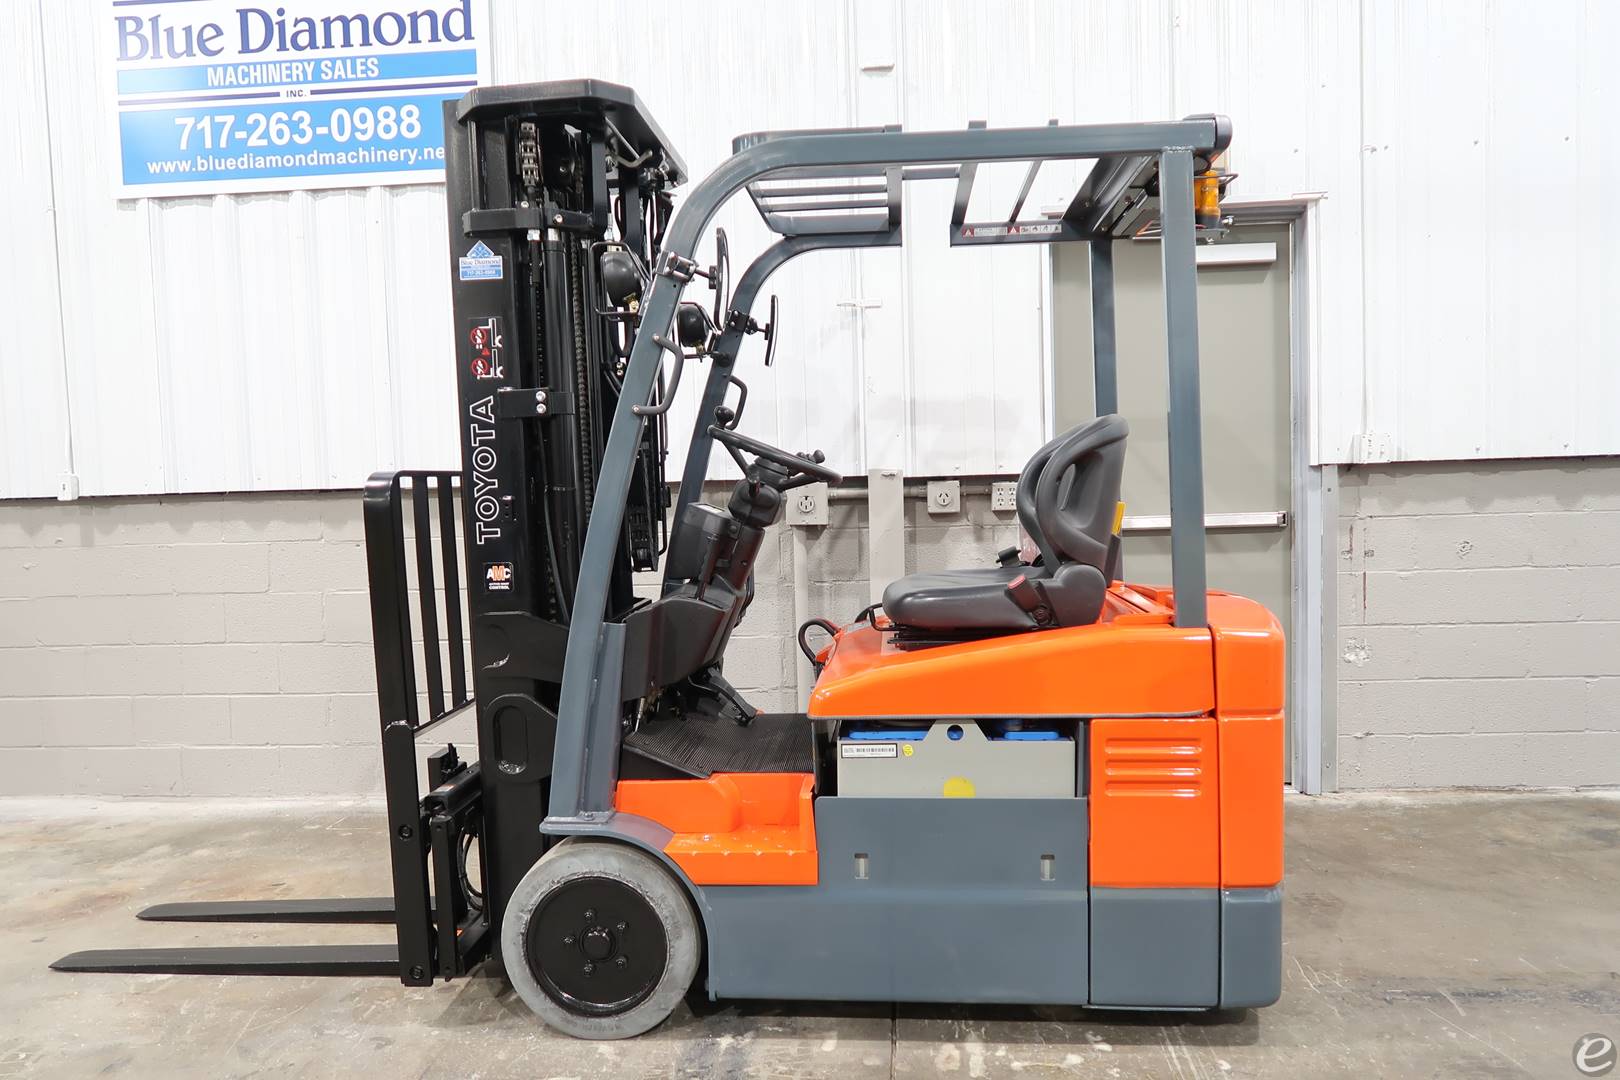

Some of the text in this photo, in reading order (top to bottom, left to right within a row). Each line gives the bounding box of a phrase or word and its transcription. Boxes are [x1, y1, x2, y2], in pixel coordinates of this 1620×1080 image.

[114, 0, 475, 62] Blue Diamond
[207, 57, 379, 87] MACHINERY SALES
[286, 88, 307, 98] INC.
[174, 104, 422, 151] 717-263-0988
[146, 147, 446, 175] www.bluediamondmachinery.ne
[470, 395, 501, 544] TOYOTA
[486, 565, 512, 581] AMC
